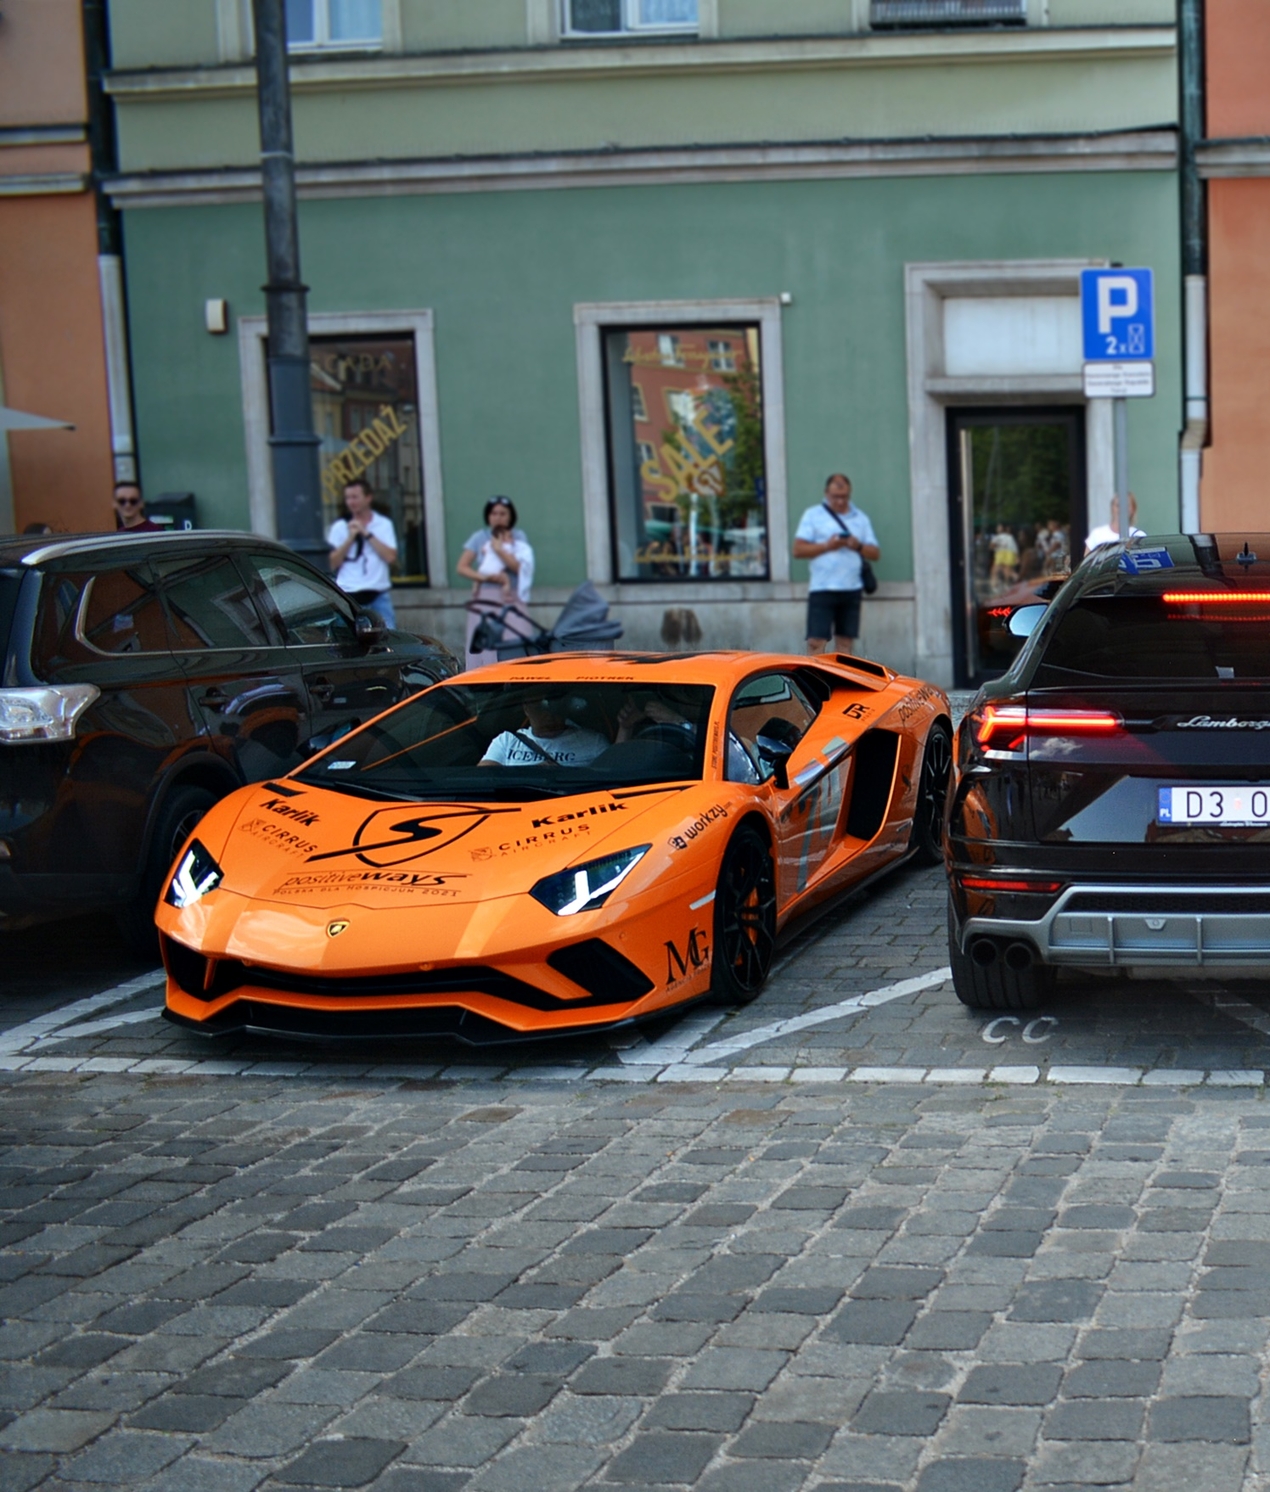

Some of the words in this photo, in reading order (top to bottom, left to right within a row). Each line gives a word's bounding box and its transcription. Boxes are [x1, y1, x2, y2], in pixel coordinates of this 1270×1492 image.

[1097, 276, 1138, 334] P
[321, 403, 408, 503] PRZEDAŻ
[640, 409, 735, 502] SALE
[259, 798, 321, 827] Karlik
[532, 802, 629, 829] Karlik
[1186, 791, 1224, 818] D3
[684, 803, 728, 838] workzy
[262, 824, 319, 853] CIRRUS
[498, 823, 590, 851] CIRRUS
[276, 871, 468, 891] positiveways
